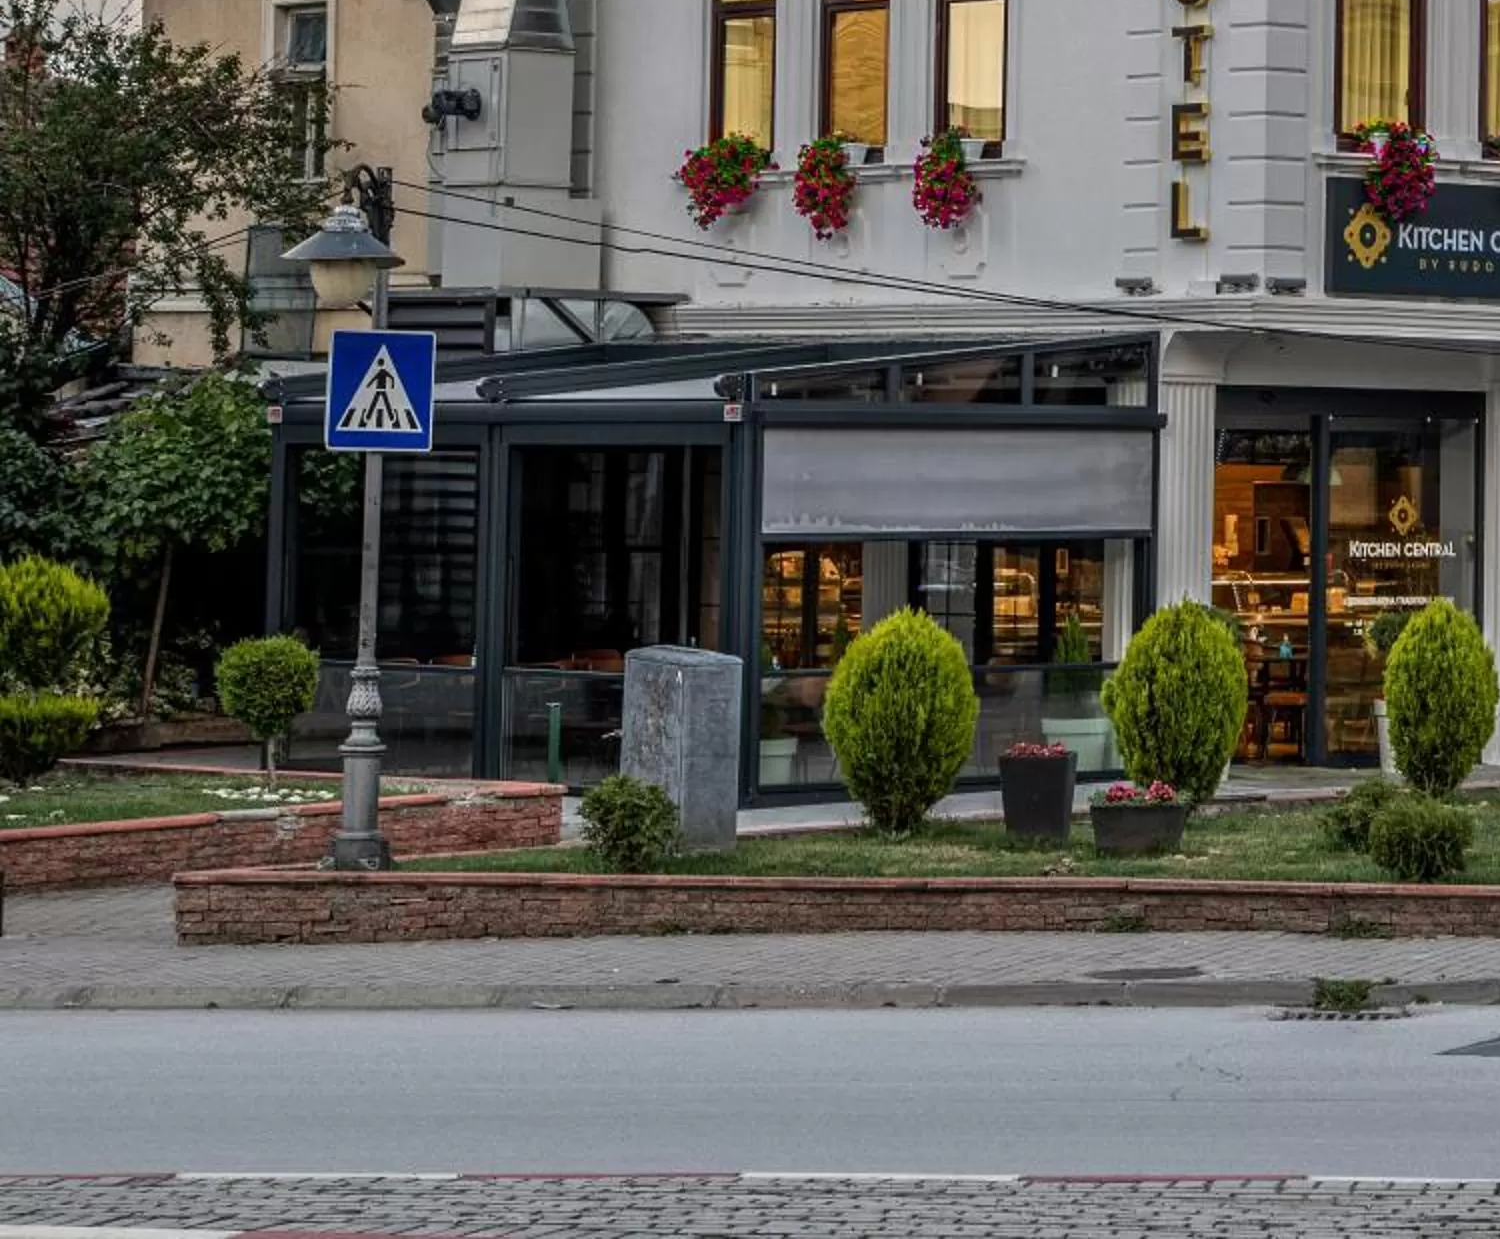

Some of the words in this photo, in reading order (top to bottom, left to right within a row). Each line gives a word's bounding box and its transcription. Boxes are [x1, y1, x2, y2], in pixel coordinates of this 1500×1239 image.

[1398, 223, 1484, 252] KITCHEN
[1419, 258, 1439, 270] BY
[1349, 540, 1400, 558] KITCHEN
[1403, 541, 1456, 557] CENTRAL
